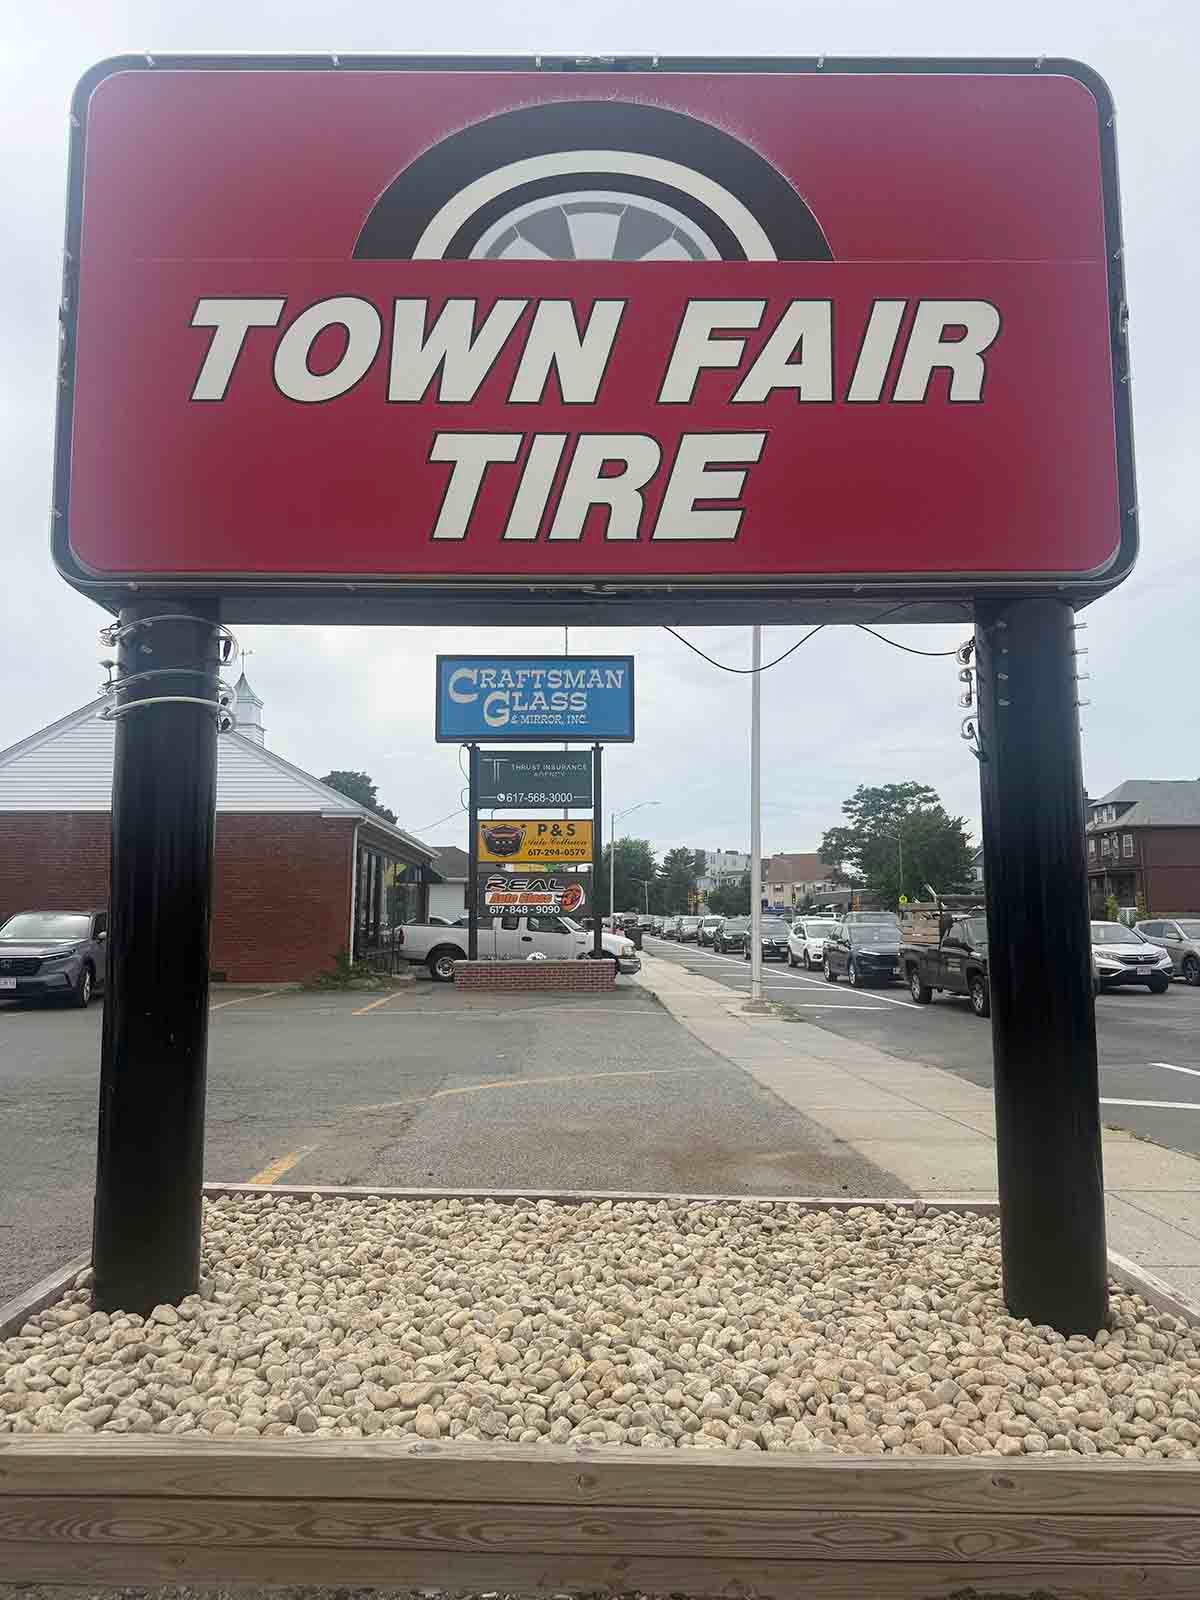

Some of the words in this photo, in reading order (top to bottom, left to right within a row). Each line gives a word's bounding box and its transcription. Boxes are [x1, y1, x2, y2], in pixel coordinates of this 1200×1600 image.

[189, 296, 626, 405] TOWN
[657, 298, 1002, 405] FAIR
[427, 430, 766, 542] TIRE
[449, 668, 625, 704] CRAFTSMAN
[483, 690, 588, 727] GLASS
[543, 763, 587, 771] INSURANCE
[506, 793, 573, 802] 617-568-3000
[537, 824, 547, 836] P
[550, 824, 563, 837] &
[566, 824, 576, 836] S
[528, 848, 586, 856] 617-294-0579
[485, 875, 566, 891] REAL
